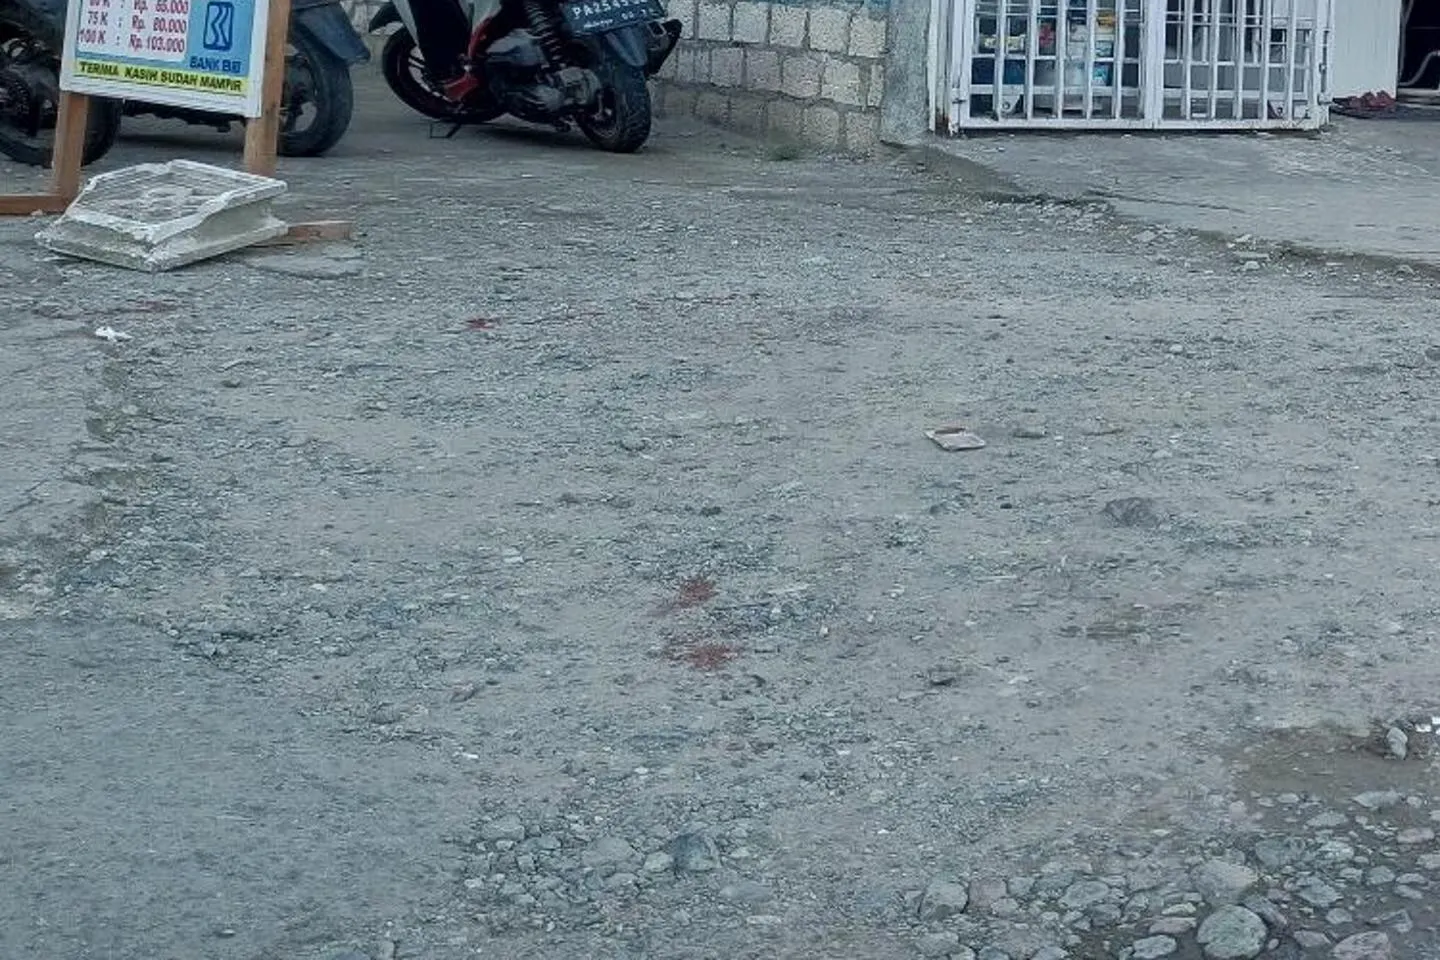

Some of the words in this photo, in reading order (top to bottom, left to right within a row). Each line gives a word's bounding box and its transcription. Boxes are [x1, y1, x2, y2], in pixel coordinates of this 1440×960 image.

[189, 57, 219, 71] BANK
[79, 61, 119, 76] TERIMA
[124, 66, 158, 81] KASIH
[161, 71, 198, 86] SUDAH
[199, 75, 242, 91] MAMPIR
